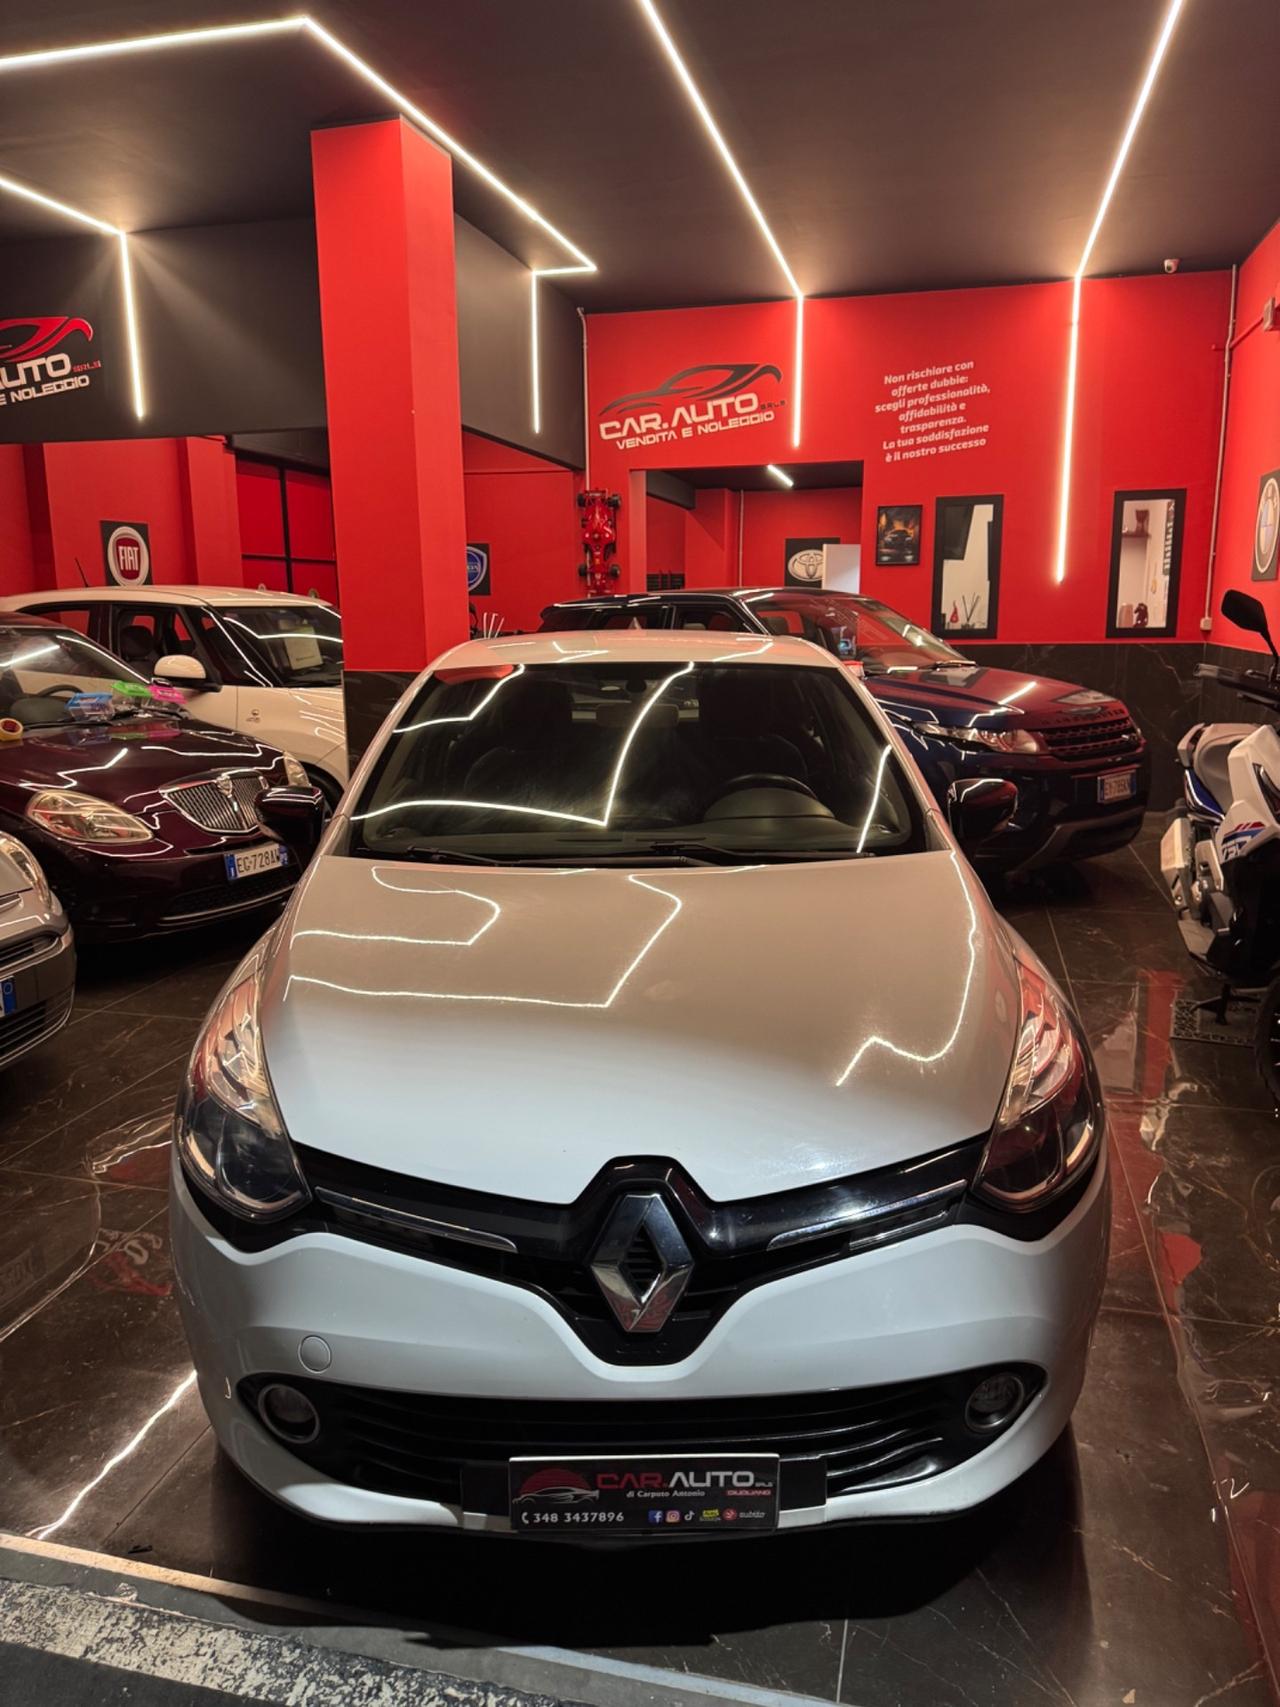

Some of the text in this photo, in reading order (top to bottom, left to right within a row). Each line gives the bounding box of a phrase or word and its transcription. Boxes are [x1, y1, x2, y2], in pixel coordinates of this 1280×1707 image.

[0, 353, 71, 390] UTO
[884, 361, 974, 384] Non rischiare con
[10, 375, 89, 402] NOLEGGIO
[891, 376, 968, 398] offerte dubbie:
[600, 393, 758, 440] CAR.AUTO
[875, 400, 905, 413] scegli
[898, 402, 966, 422] affidabilità e
[616, 411, 775, 449] VENDITA E NOLEGGIO
[900, 416, 967, 434] trasparenza.
[883, 425, 989, 450] La tua soddisfazione
[885, 438, 987, 462] è il nostro successo
[118, 546, 139, 571] FIAT
[672, 1489, 705, 1497] Antonio
[533, 1512, 558, 1523] 348
[564, 1511, 624, 1523] 3437896
